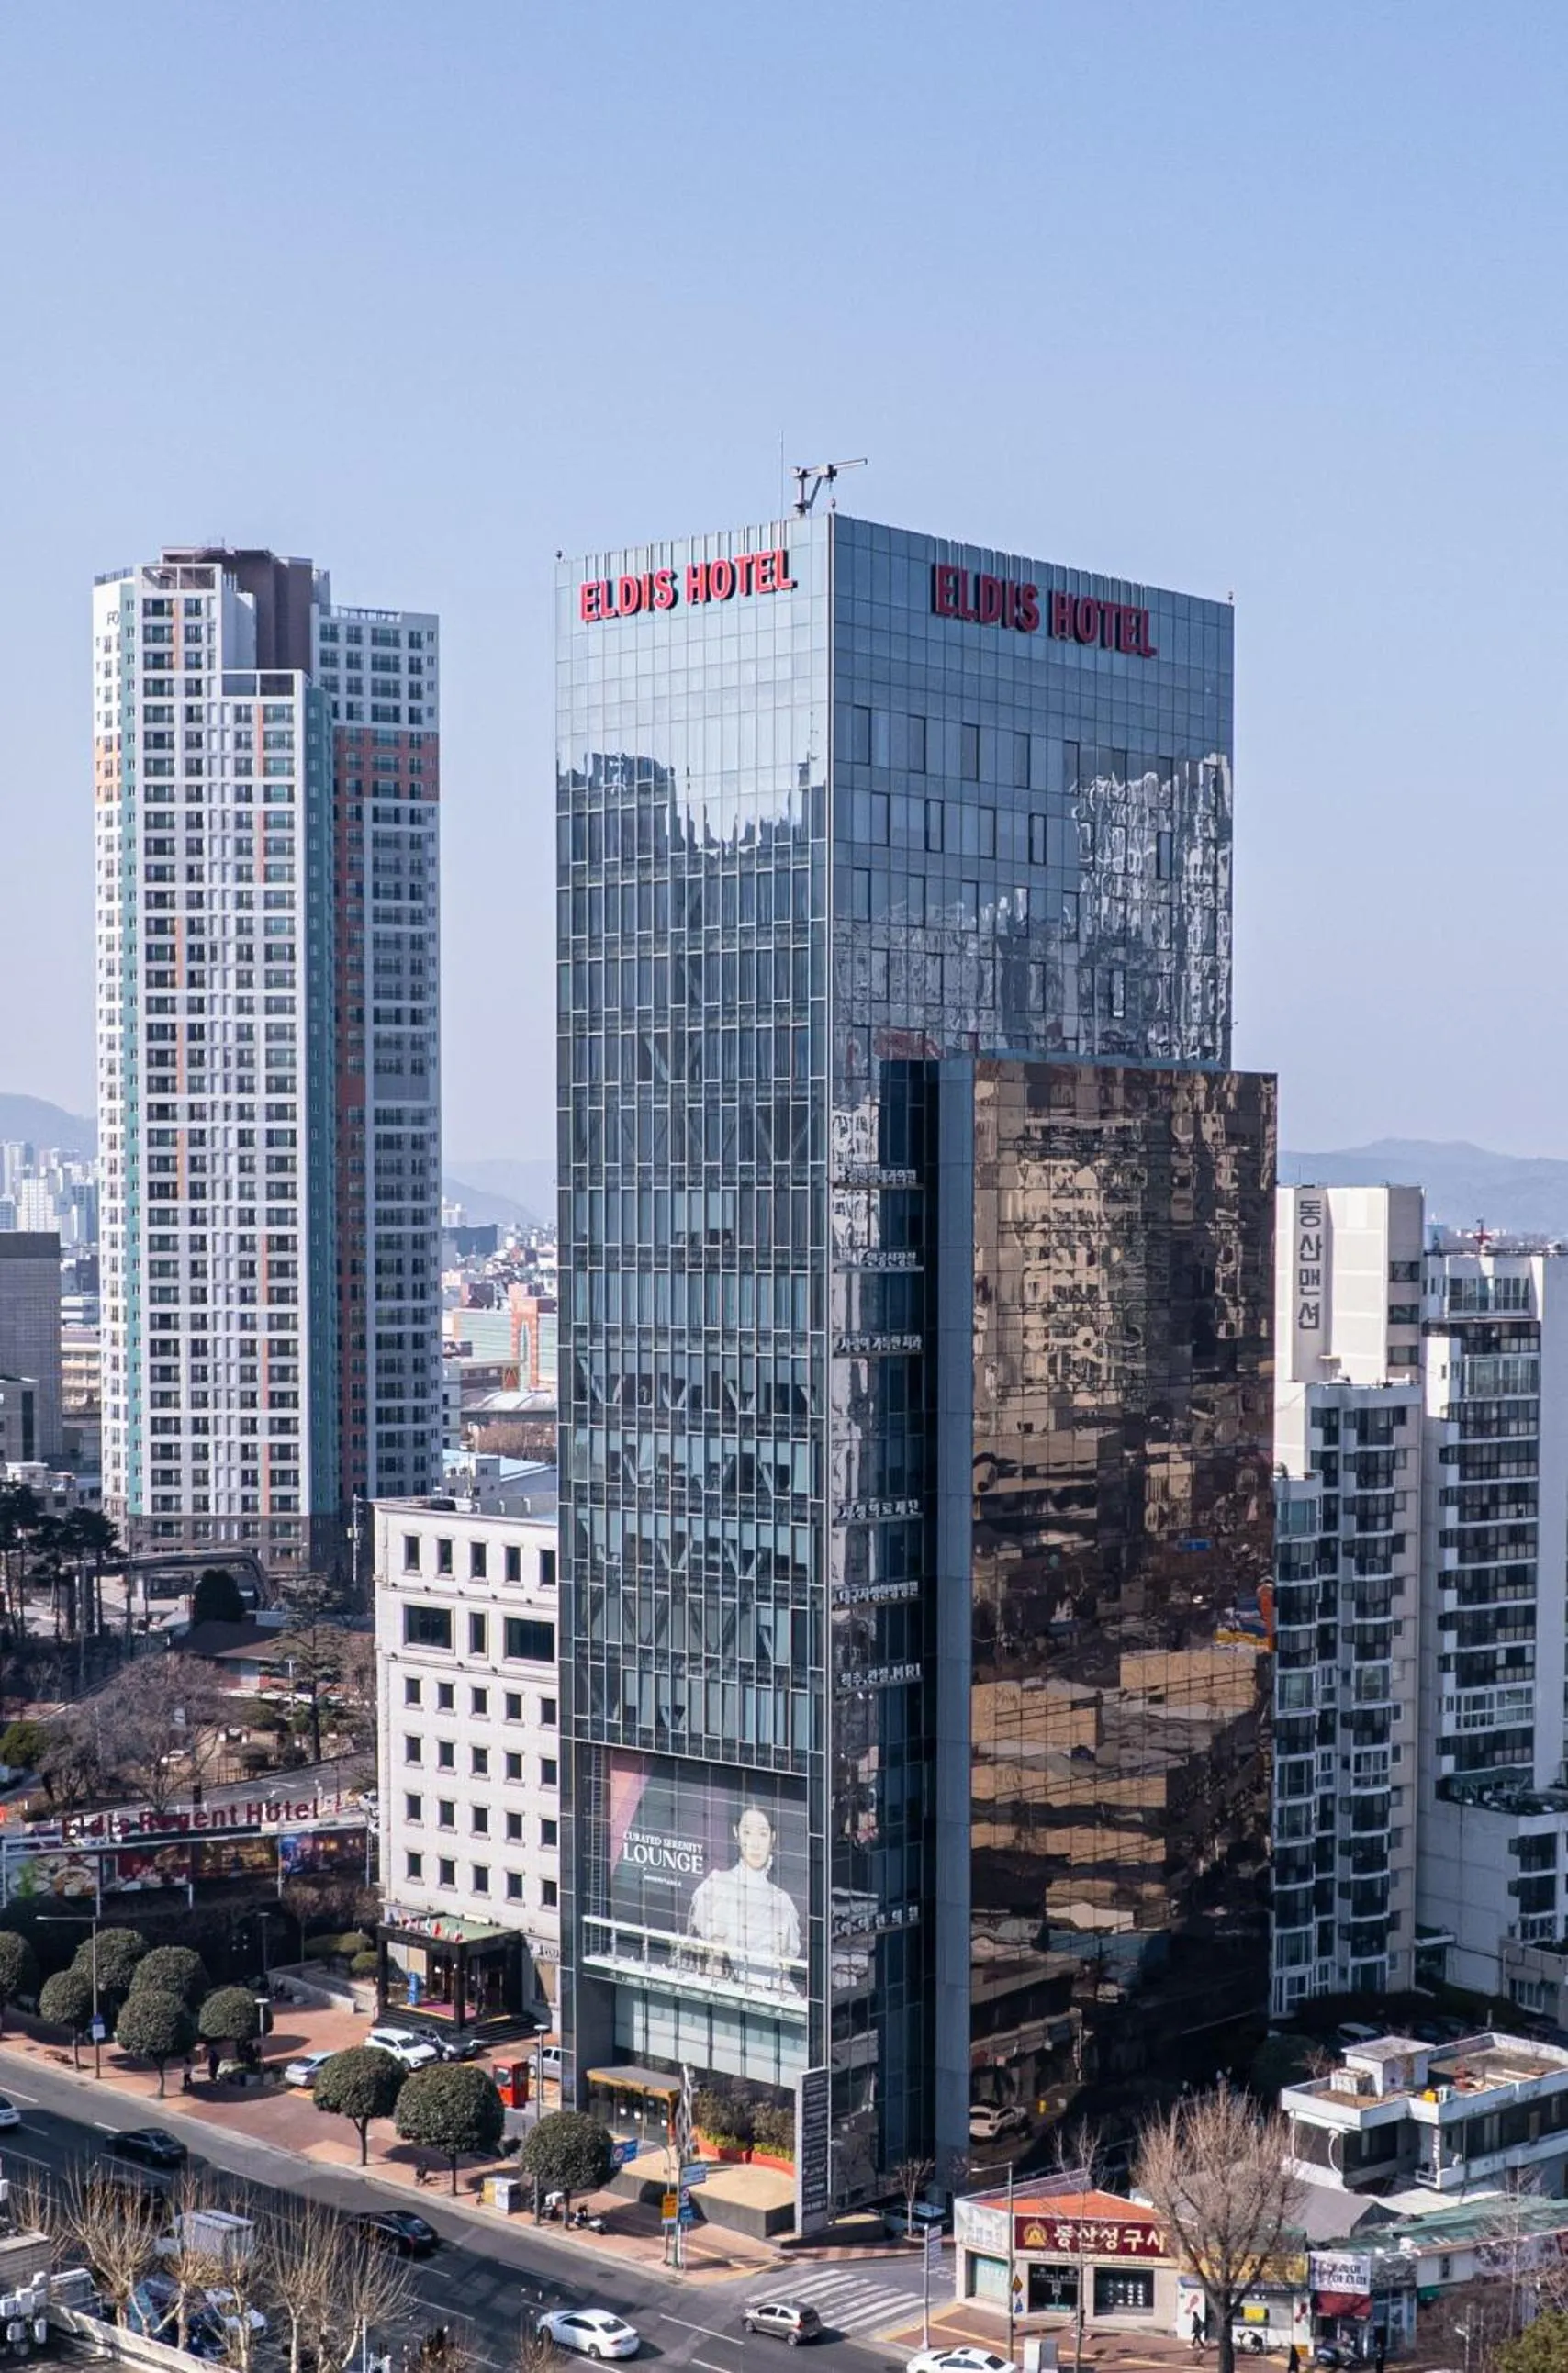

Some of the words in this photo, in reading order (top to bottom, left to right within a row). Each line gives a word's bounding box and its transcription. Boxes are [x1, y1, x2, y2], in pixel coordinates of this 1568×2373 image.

[580, 568, 676, 622] ELDIS
[686, 548, 796, 606] HOTEL
[933, 564, 1041, 633] ELDIS
[1049, 590, 1158, 658] HOTEL
[1298, 1200, 1323, 1330] 동산맨션
[139, 1805, 238, 1833] Regent
[246, 1797, 319, 1825] Hotel
[623, 1842, 704, 1874] LOUNGE
[1054, 2223, 1167, 2253] 동산성구사
